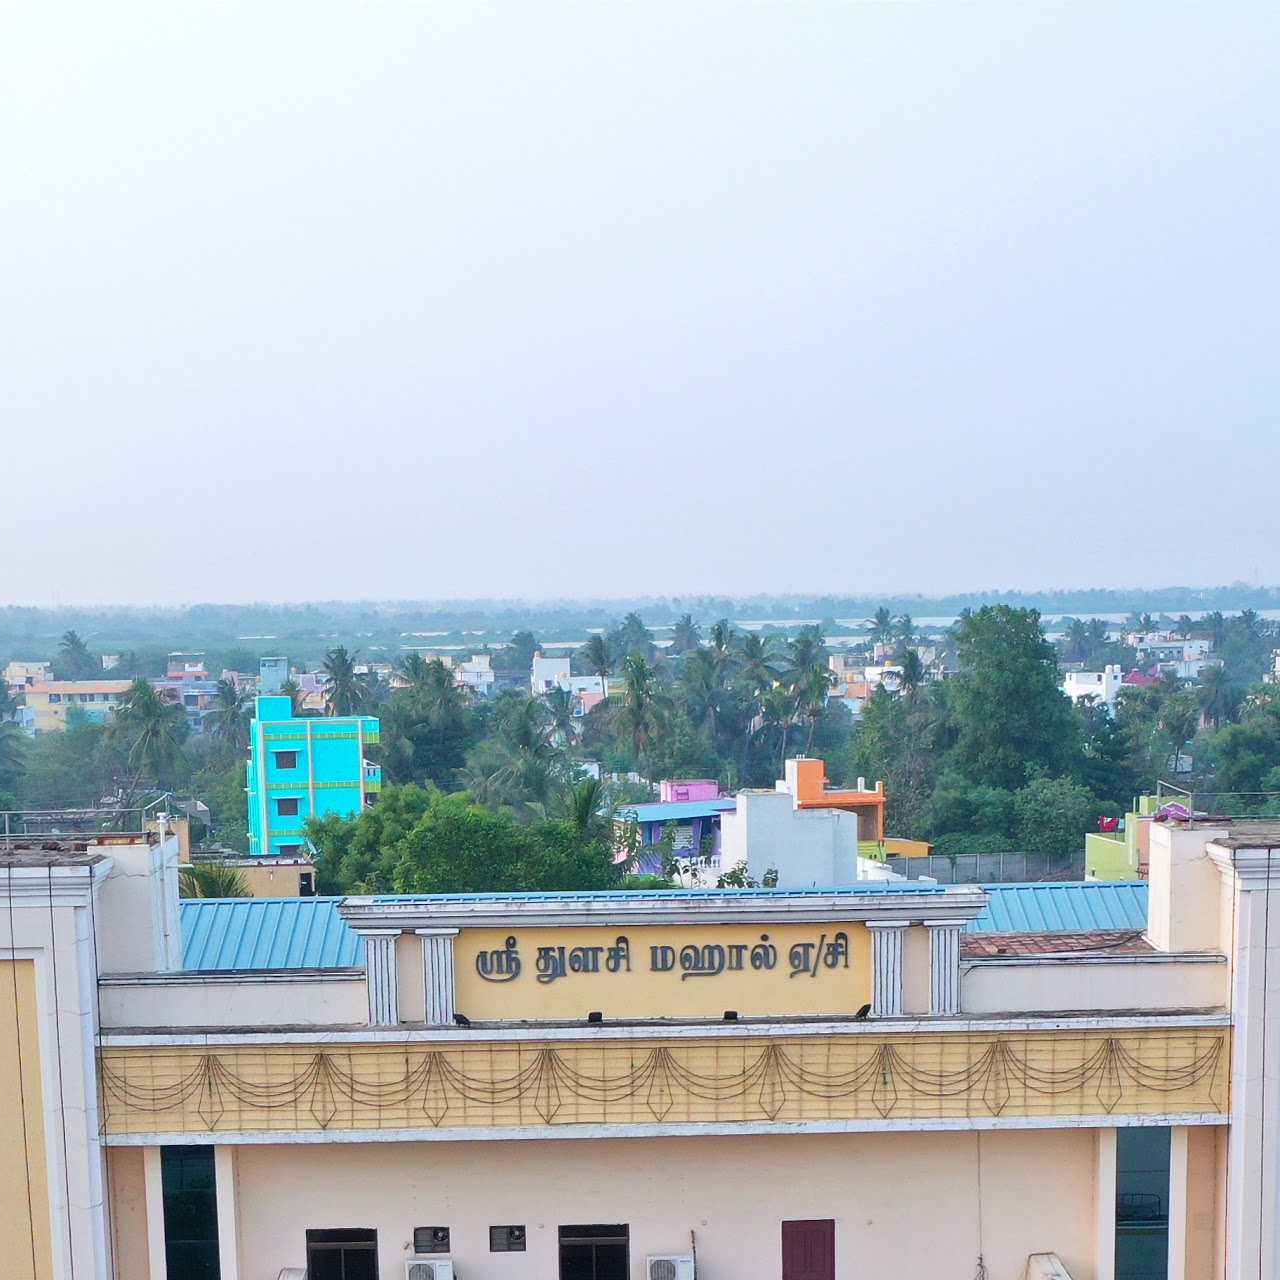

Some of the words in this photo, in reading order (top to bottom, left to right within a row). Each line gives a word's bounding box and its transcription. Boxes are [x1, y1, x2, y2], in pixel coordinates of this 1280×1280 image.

[535, 935, 632, 985] துளசி
[649, 933, 777, 982] மஹால்
[789, 931, 850, 980] ஏ/சி
